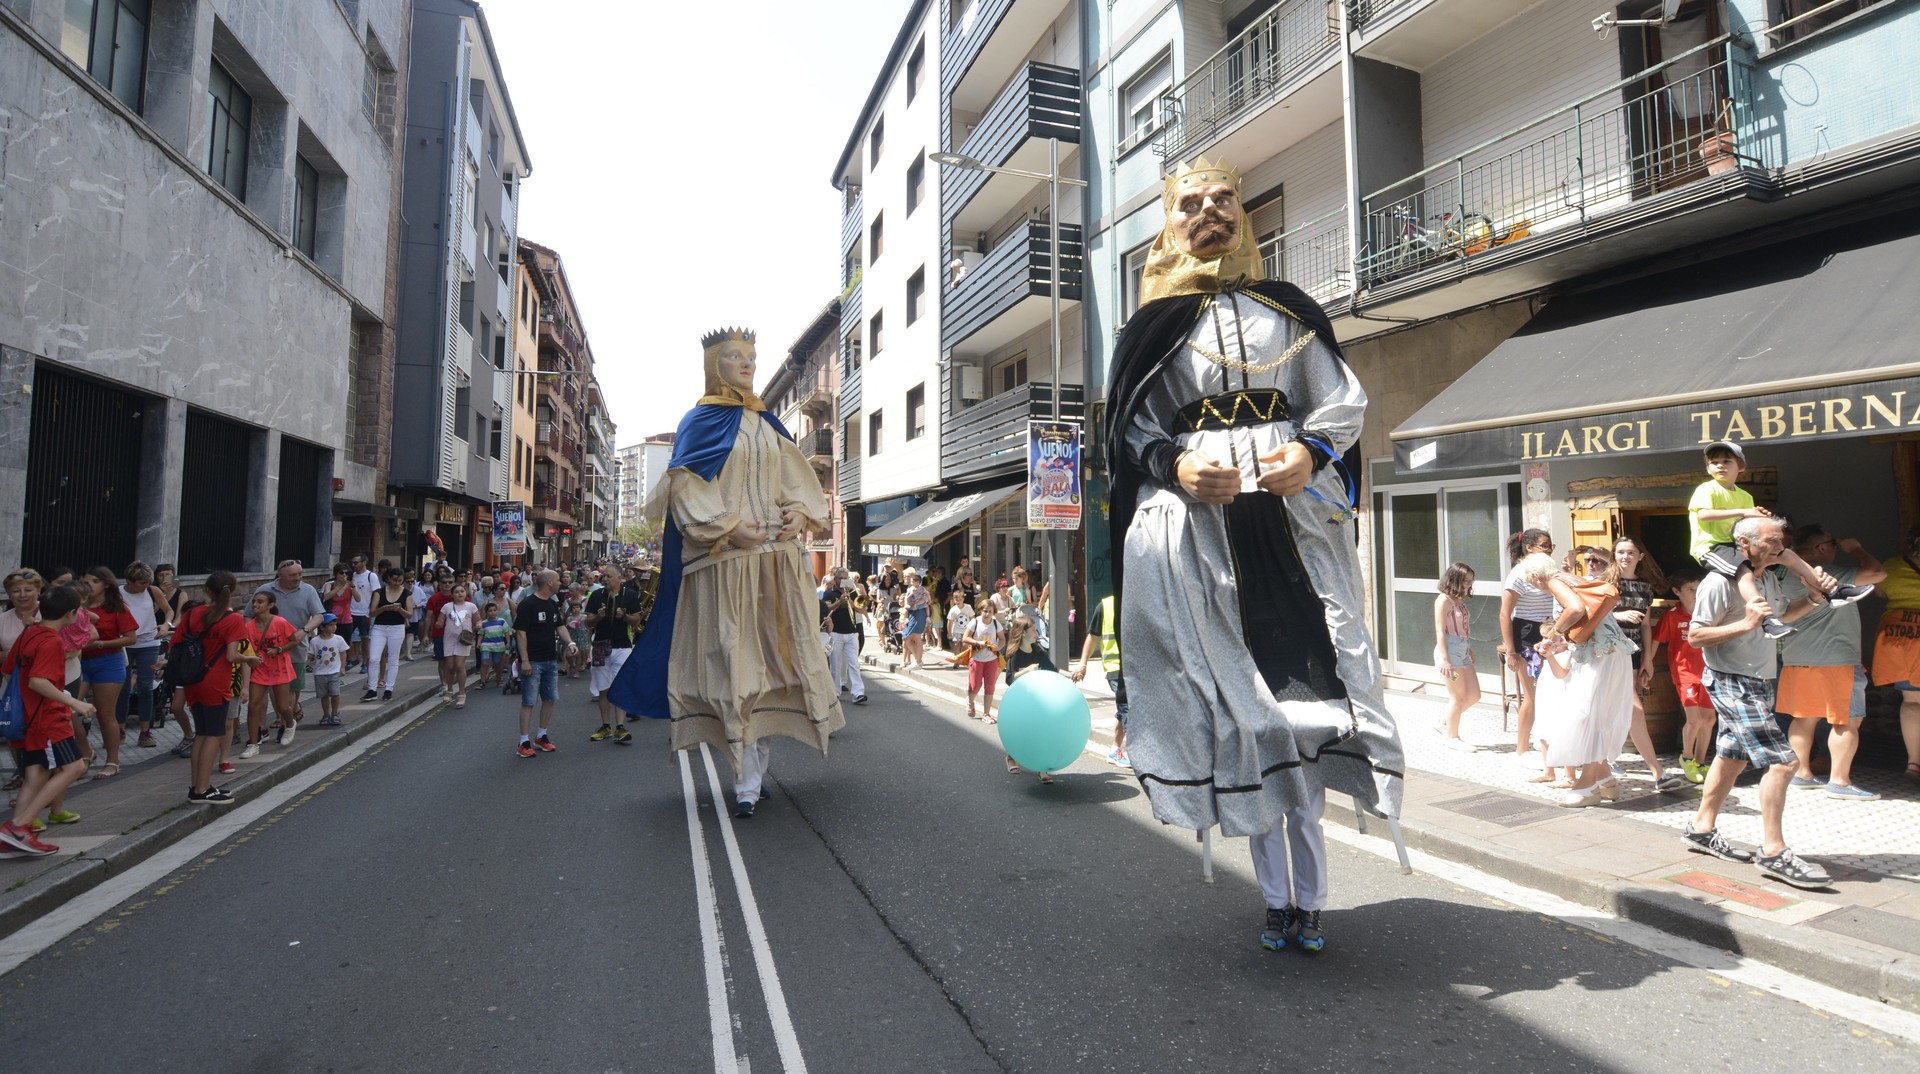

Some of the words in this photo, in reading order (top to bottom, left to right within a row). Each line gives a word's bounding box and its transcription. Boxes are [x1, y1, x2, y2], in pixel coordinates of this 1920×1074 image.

[1038, 437, 1073, 459] SUEÑOS
[1521, 419, 1651, 460] ILARGI
[1041, 482, 1071, 498] BALA
[495, 510, 522, 525] SUEÑOS
